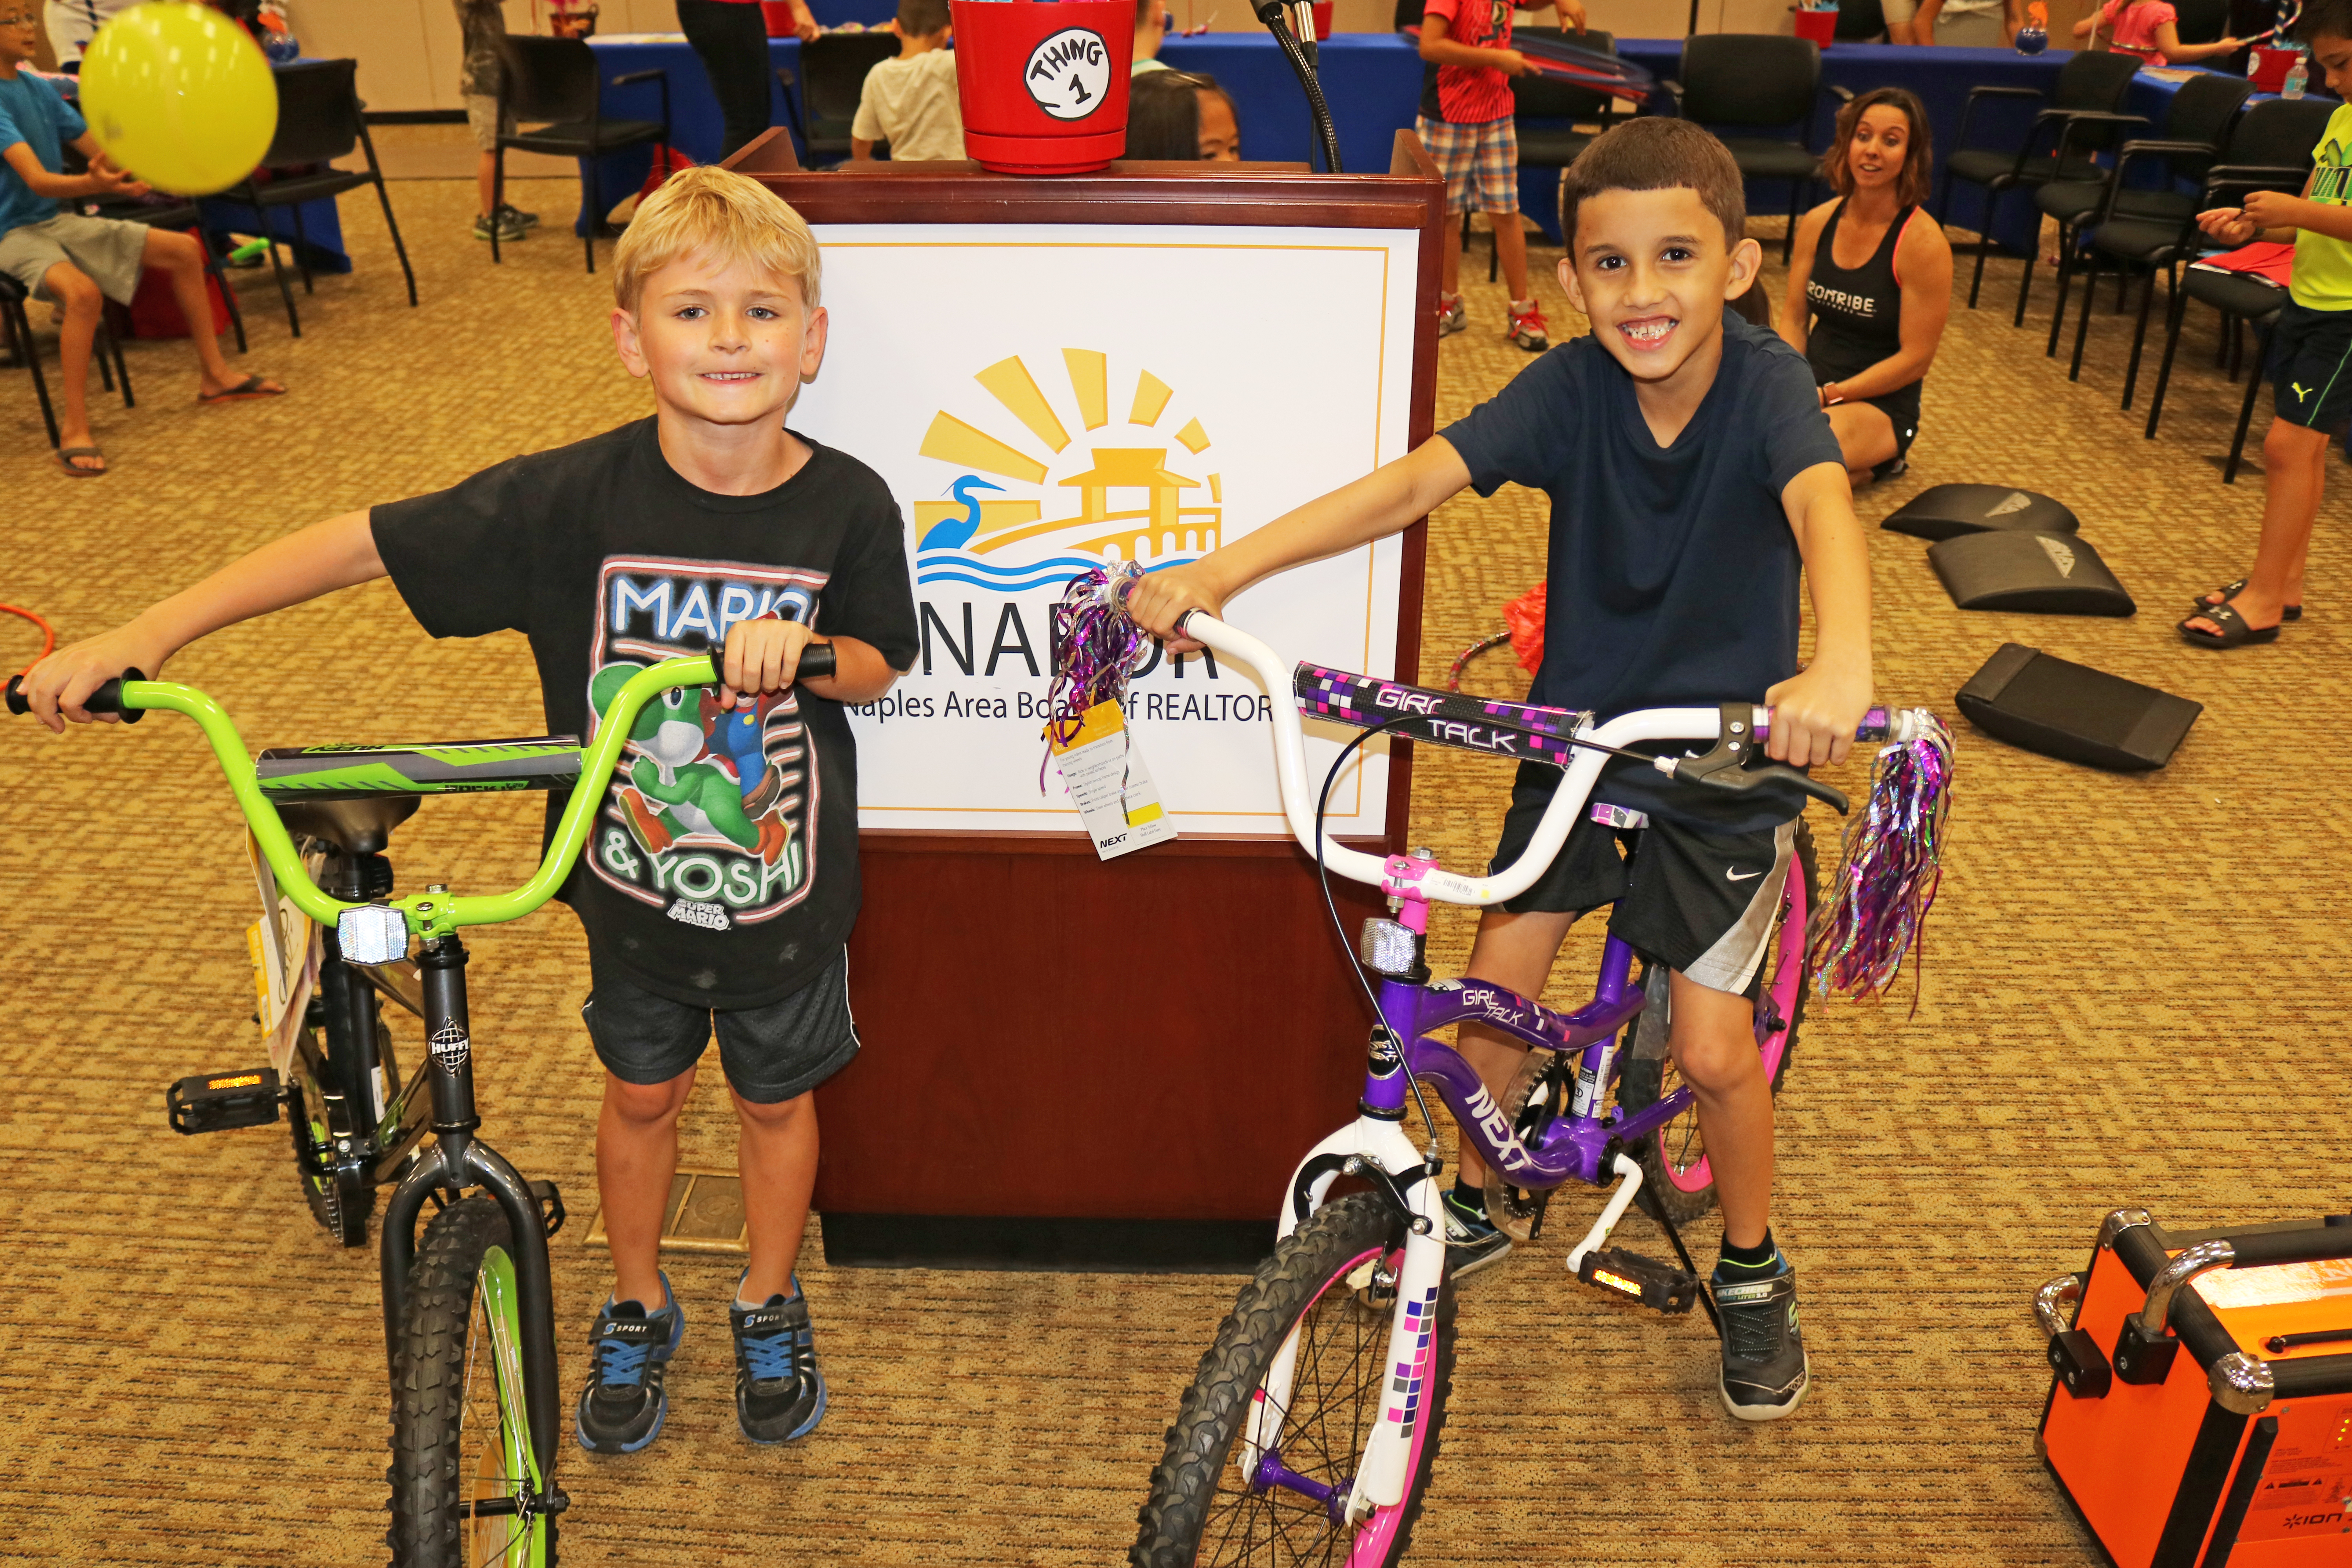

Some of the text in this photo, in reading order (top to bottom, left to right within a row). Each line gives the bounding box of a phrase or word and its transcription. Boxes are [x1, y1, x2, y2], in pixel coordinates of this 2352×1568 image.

[1029, 38, 1103, 81] THING
[1069, 74, 1092, 104] 1
[944, 691, 1007, 718] Area
[1427, 719, 1517, 753] TALK
[1087, 760, 1109, 771] neighborhoods
[1100, 833, 1127, 848] NEXT
[605, 831, 799, 904] & YOSHI
[668, 904, 730, 931] MARIO
[676, 898, 724, 915] SUPER
[1463, 990, 1499, 1009] GIRL
[1483, 1006, 1523, 1025] TALK
[431, 1038, 469, 1055] HUFFY
[1466, 1083, 1534, 1173] NEXT
